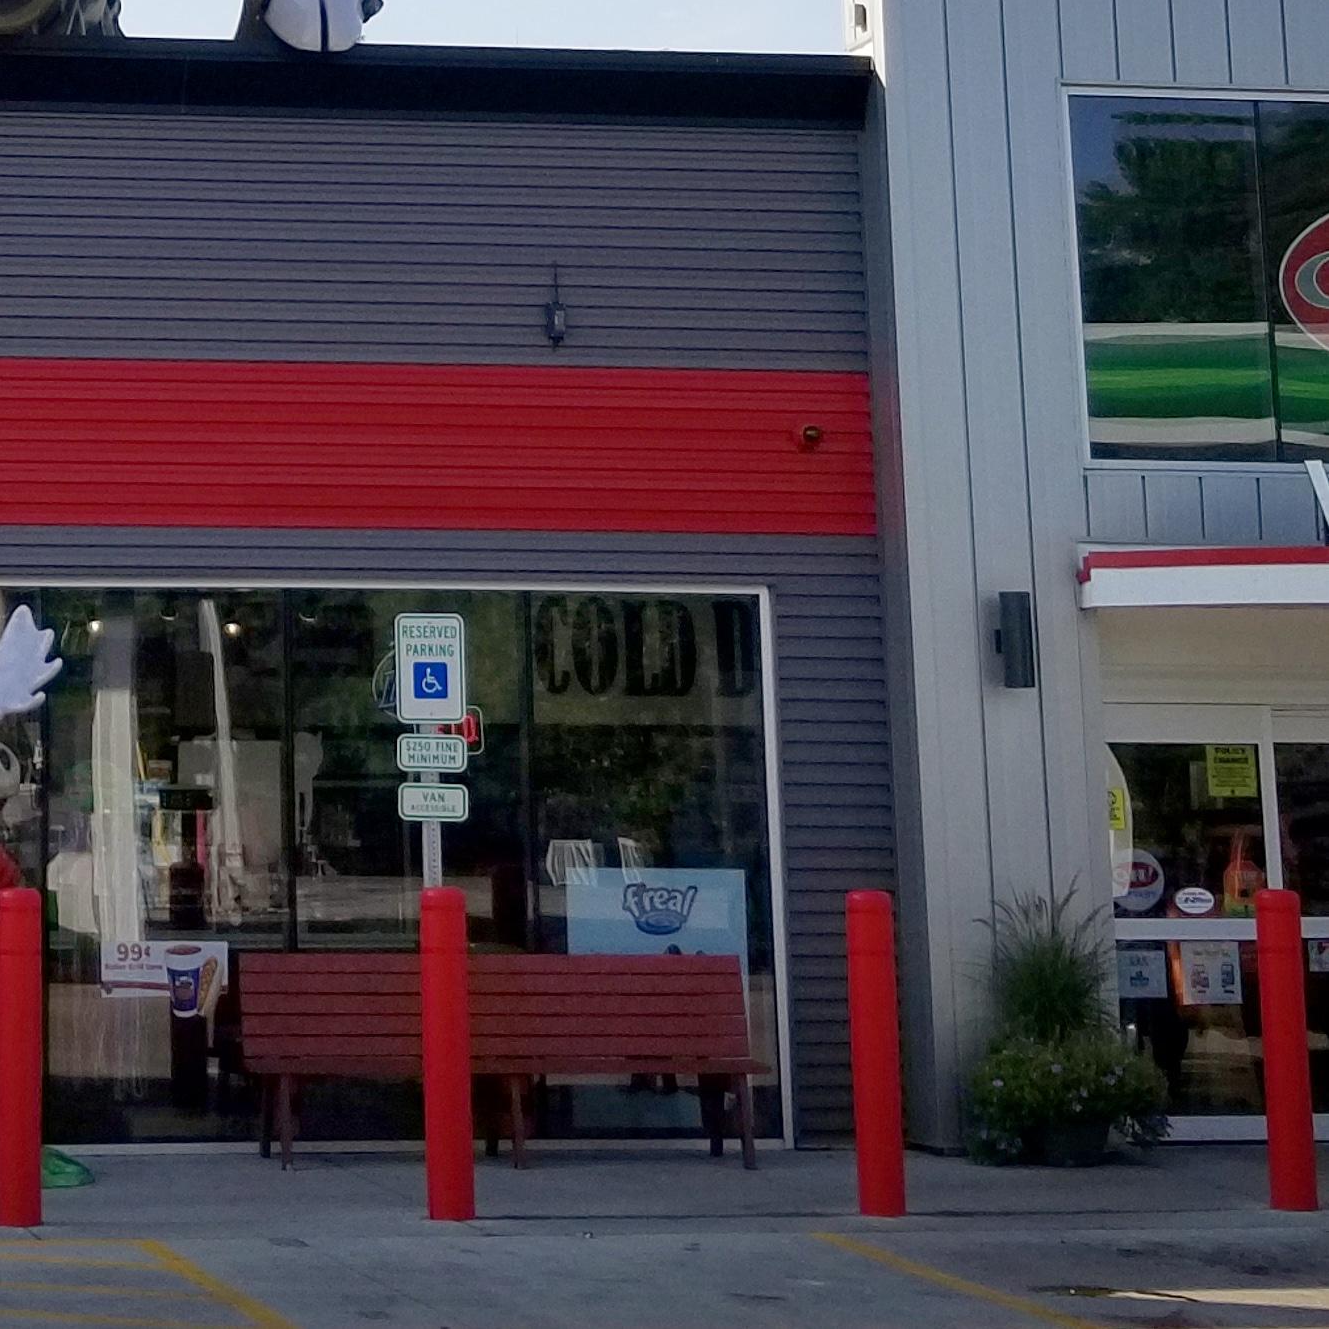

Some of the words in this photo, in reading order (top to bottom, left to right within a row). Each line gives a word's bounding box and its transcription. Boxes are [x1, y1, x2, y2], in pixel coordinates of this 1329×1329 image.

[401, 625, 457, 639] RESERVED
[405, 643, 455, 657] PARKING
[535, 595, 697, 697] COLD
[405, 740, 431, 752] $250
[434, 741, 459, 753] FINE
[408, 753, 457, 765] MINIMUM
[421, 791, 446, 803] VAN
[117, 942, 151, 962] 99¢
